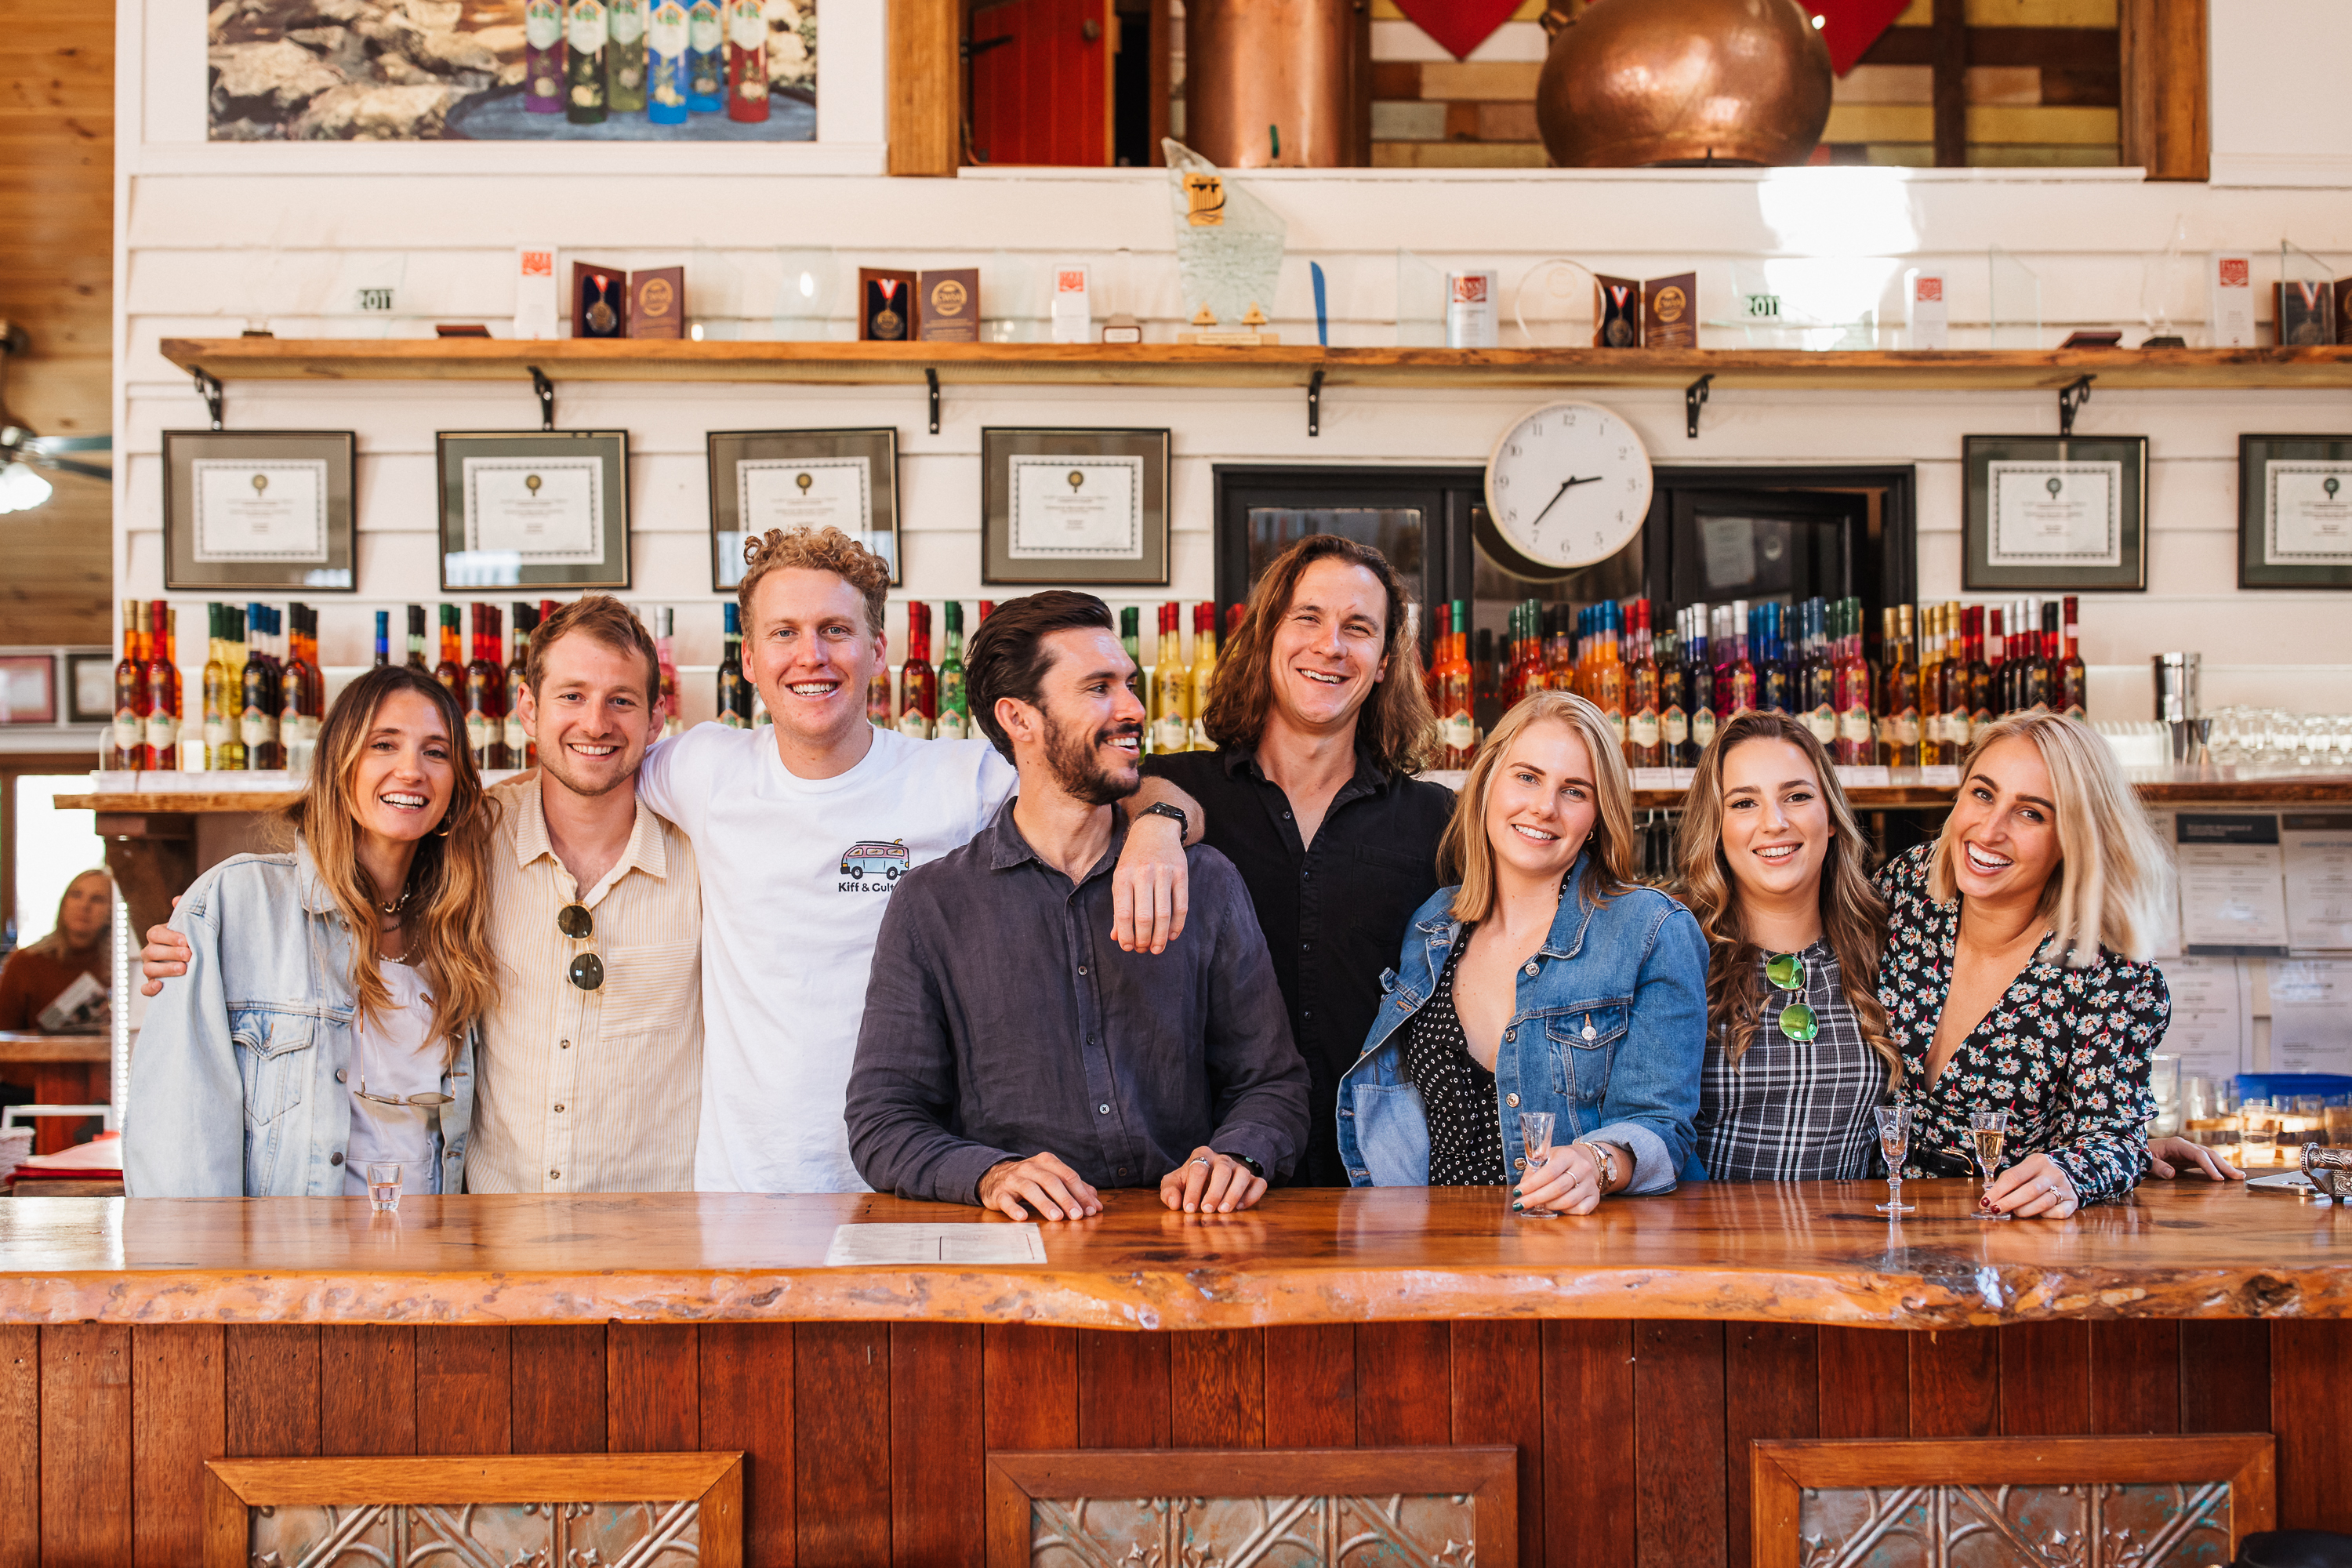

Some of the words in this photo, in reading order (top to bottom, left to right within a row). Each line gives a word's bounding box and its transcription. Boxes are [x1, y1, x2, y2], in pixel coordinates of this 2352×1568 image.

[356, 289, 394, 309] 2011
[1741, 295, 1780, 317] 2011
[1563, 413, 1576, 426] 12
[1533, 423, 1543, 437] 11
[1510, 445, 1523, 456] 10
[838, 881, 859, 892] Kiff
[862, 883, 870, 892] &
